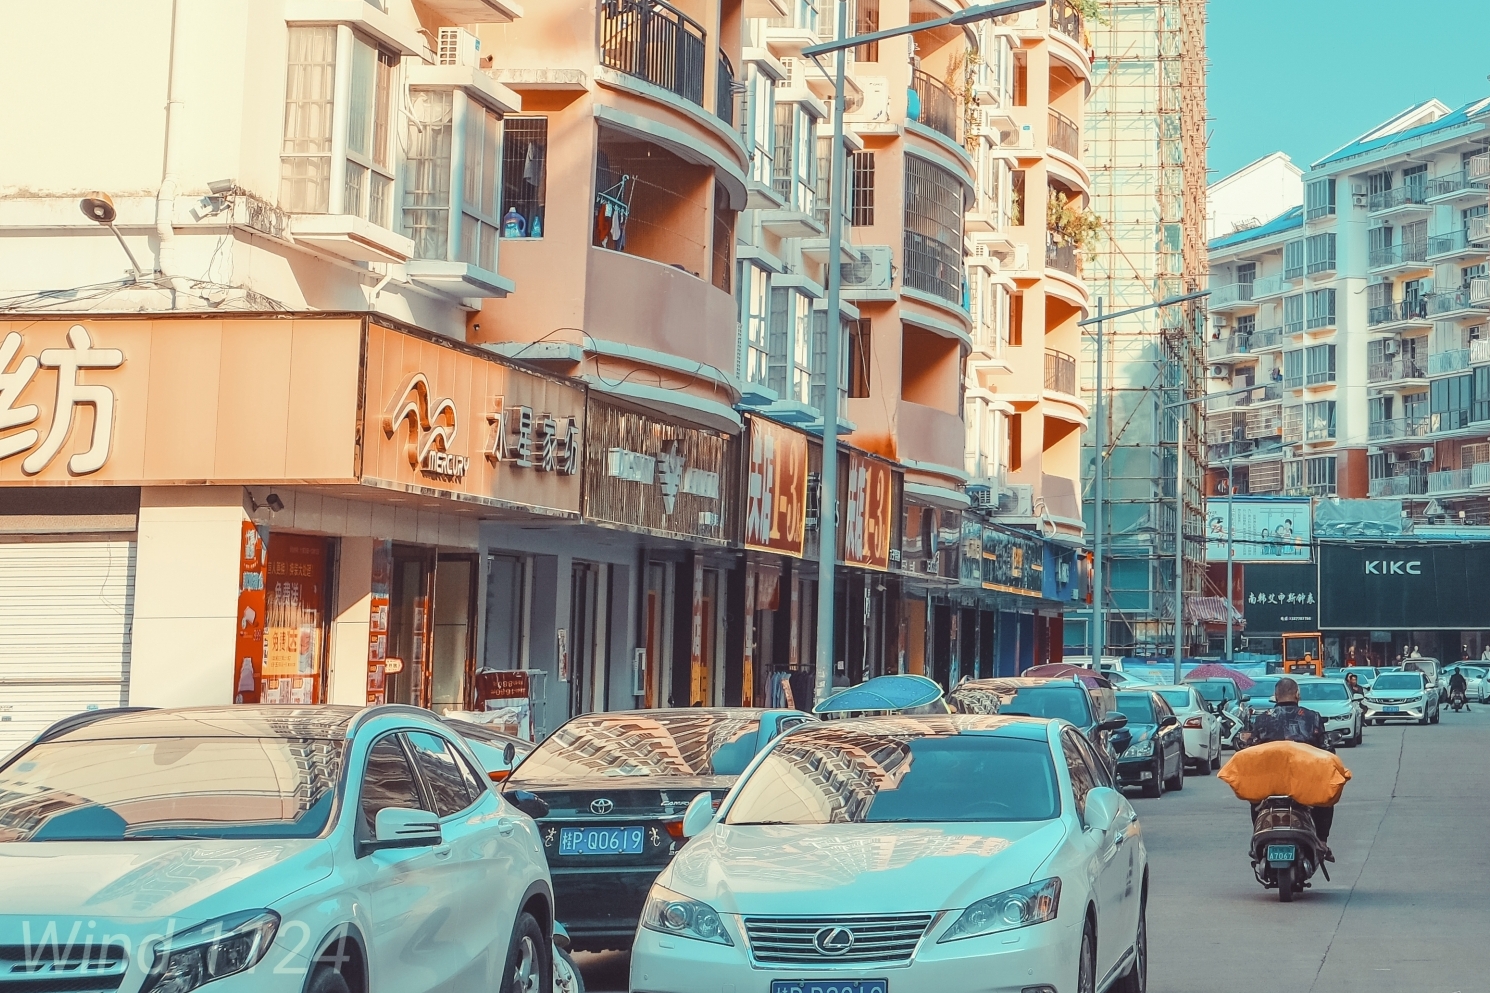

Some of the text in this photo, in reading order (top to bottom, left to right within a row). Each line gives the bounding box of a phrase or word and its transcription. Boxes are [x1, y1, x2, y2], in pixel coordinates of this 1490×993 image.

[486, 395, 579, 476] 水星家纺
[427, 451, 470, 477] MERCURY
[1365, 560, 1422, 575] KIKC
